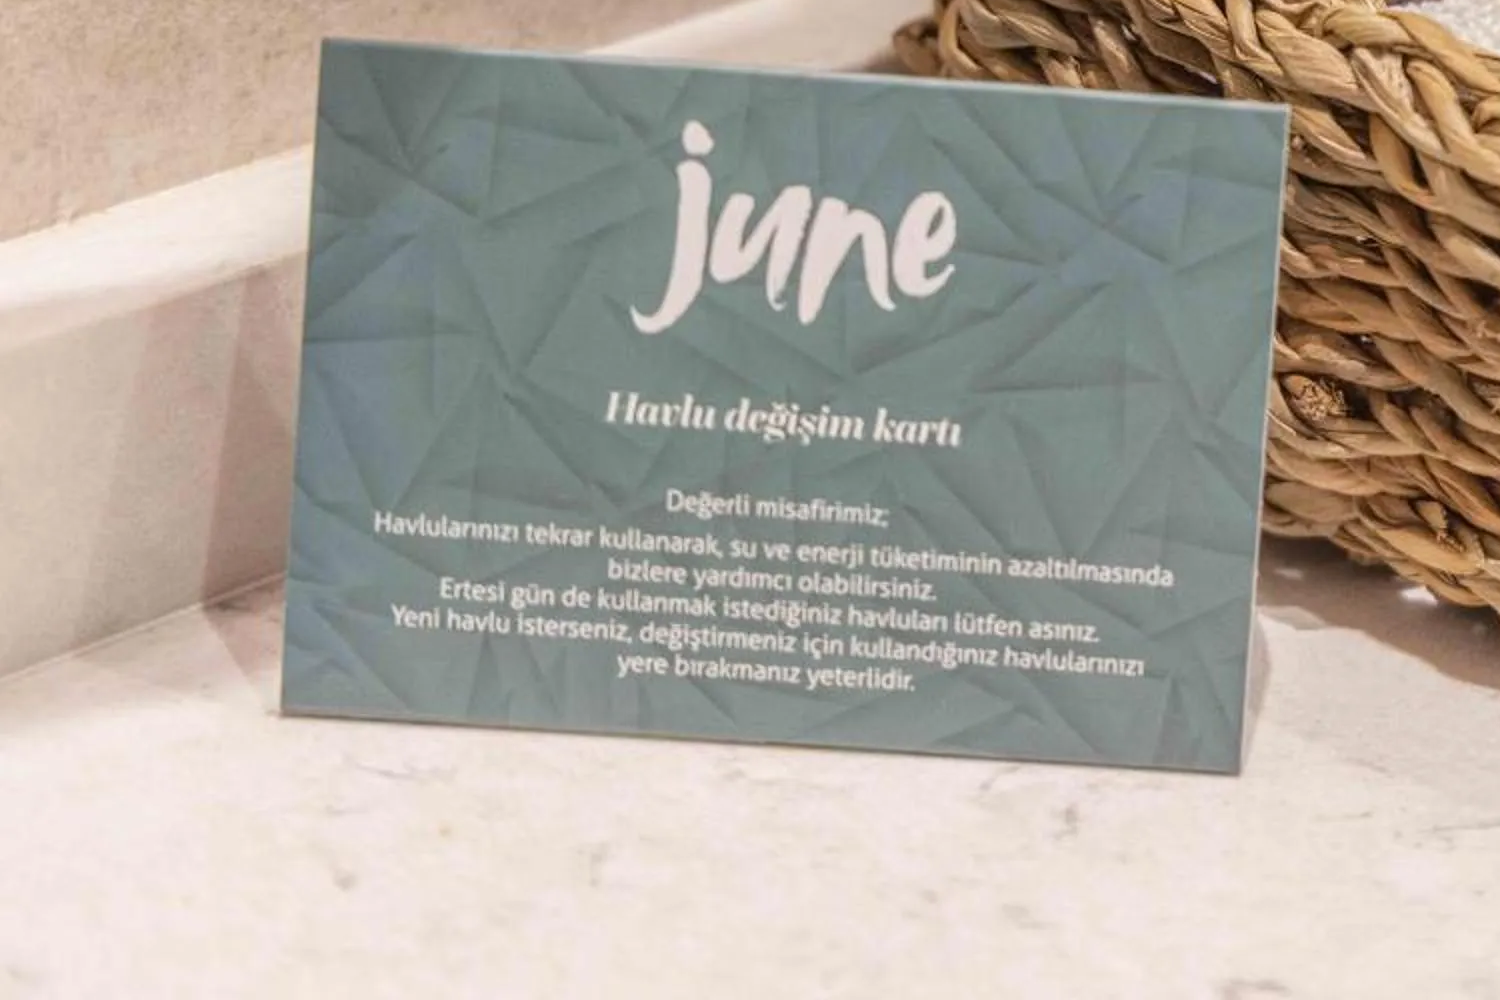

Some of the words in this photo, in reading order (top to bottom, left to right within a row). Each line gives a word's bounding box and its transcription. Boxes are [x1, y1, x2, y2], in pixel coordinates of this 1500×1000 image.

[630, 119, 957, 335] june
[605, 391, 716, 430] Havlu
[724, 396, 865, 446] değişim
[873, 407, 962, 448] kartı
[665, 487, 750, 520] Değerli
[373, 510, 519, 541] Havlularınızı
[525, 520, 594, 547] tekrar
[599, 526, 724, 559] kullanarak,
[730, 540, 759, 558] su
[763, 543, 791, 561] ve
[797, 544, 864, 569] enerji
[870, 547, 1002, 575] tüketiminin
[1007, 554, 1175, 587] azaltılmasında
[607, 558, 687, 583] bizlere
[693, 563, 792, 592] yardımcı
[798, 569, 937, 600] olabilirsiniz.
[440, 577, 505, 602] Ertesi
[511, 583, 555, 610] gün
[561, 584, 590, 608] de
[597, 587, 715, 617] kullanmak
[722, 596, 842, 628] istediğiniz
[847, 604, 948, 633] havluları
[953, 611, 1023, 637] lütfen
[1028, 620, 1100, 642] asınız.
[391, 604, 440, 630] Yeni
[447, 608, 511, 634] havlu
[517, 613, 633, 643] isterseniz,
[639, 619, 800, 653] değiştirmeniz
[803, 631, 845, 660] için
[849, 633, 999, 669] kullandığınız
[1003, 647, 1145, 677] havlularınızı
[617, 656, 670, 678] yere
[674, 654, 800, 684] bırakmanız
[806, 664, 916, 692] yeterlidir.
